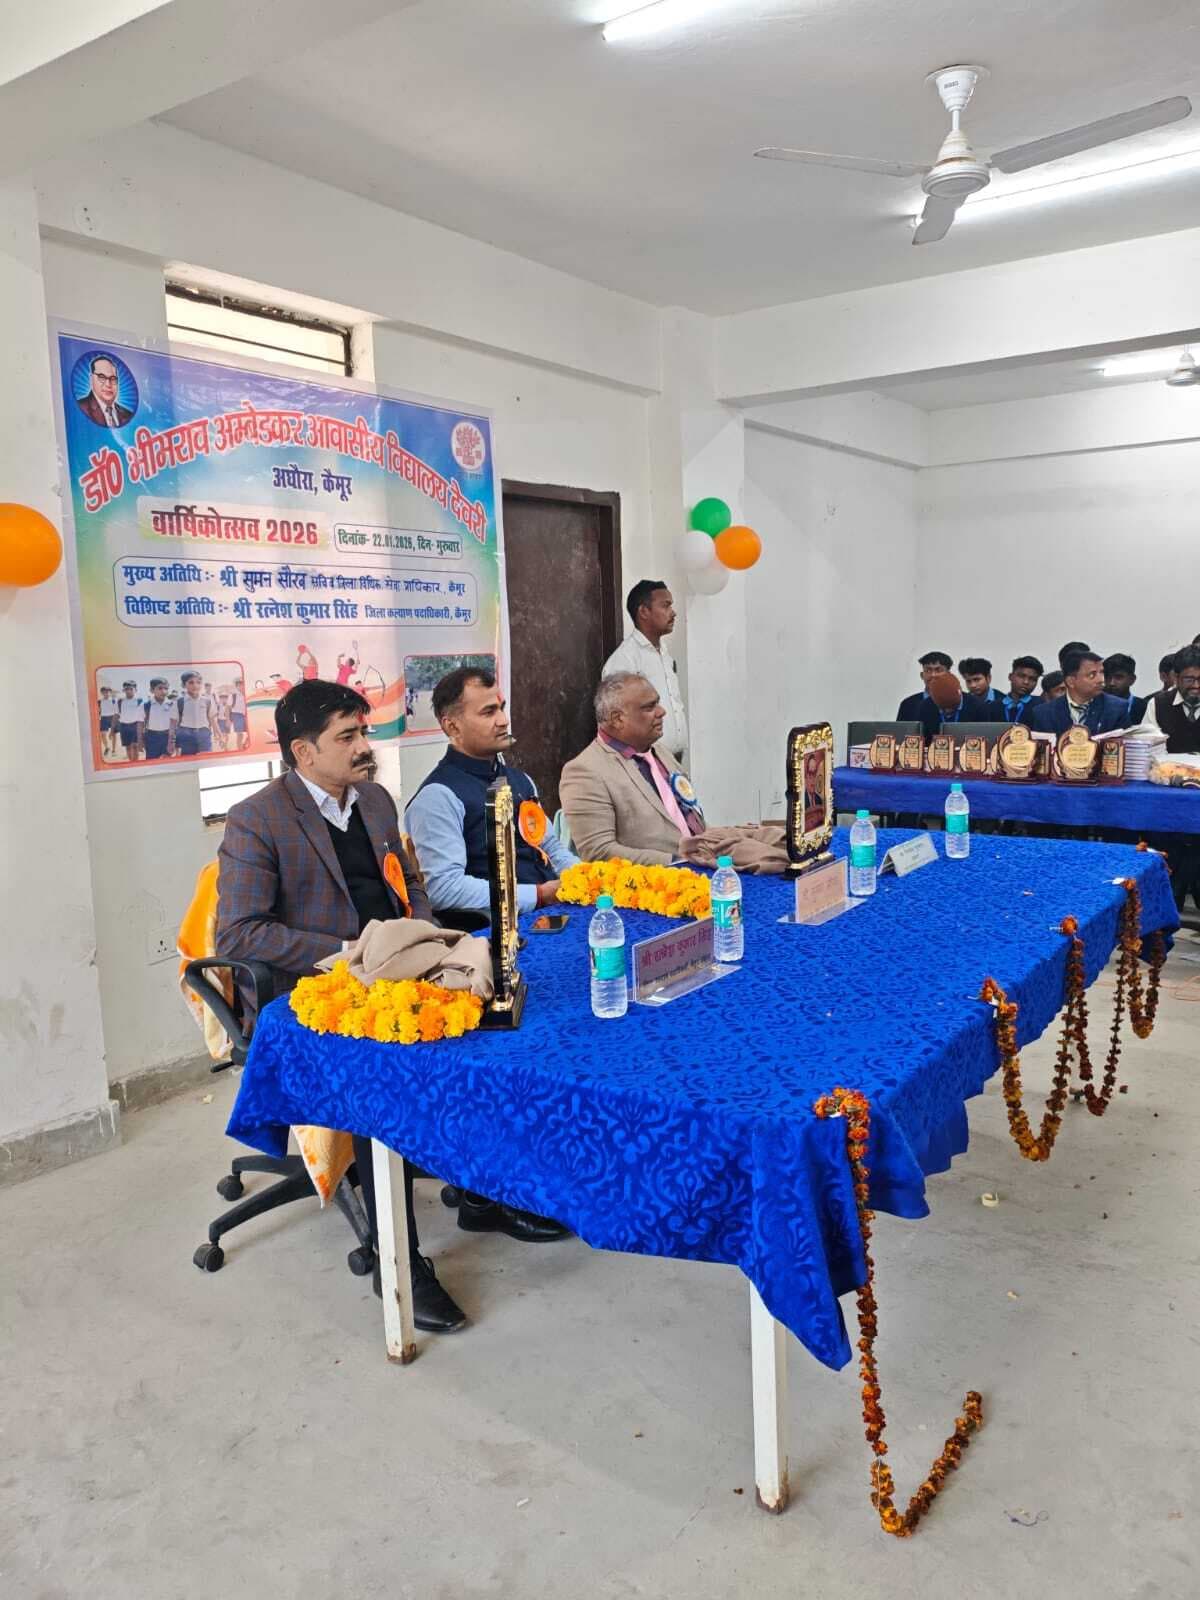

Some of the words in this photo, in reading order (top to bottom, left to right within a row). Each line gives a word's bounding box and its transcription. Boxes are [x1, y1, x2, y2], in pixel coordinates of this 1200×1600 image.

[128, 418, 210, 483] भीमराव
[213, 400, 304, 452] अम्बेडकर
[306, 416, 385, 468] आवासीय
[386, 431, 449, 510] विद्यालय
[320, 468, 352, 502] कैमूर
[151, 505, 260, 541] वार्षिकोत्सव
[266, 519, 318, 545] 2026
[338, 528, 370, 545] दिनांक-
[122, 566, 156, 586] मुख्य
[160, 563, 202, 582] अतिथि
[220, 565, 238, 587] श्री
[242, 571, 272, 593] सुमन
[125, 595, 171, 615] विशिष्ट
[175, 596, 215, 615] अतिथि
[233, 597, 252, 618] श्री
[255, 598, 293, 618] रत्नेश
[295, 603, 331, 624] कुमार
[333, 598, 358, 618] सिंह
